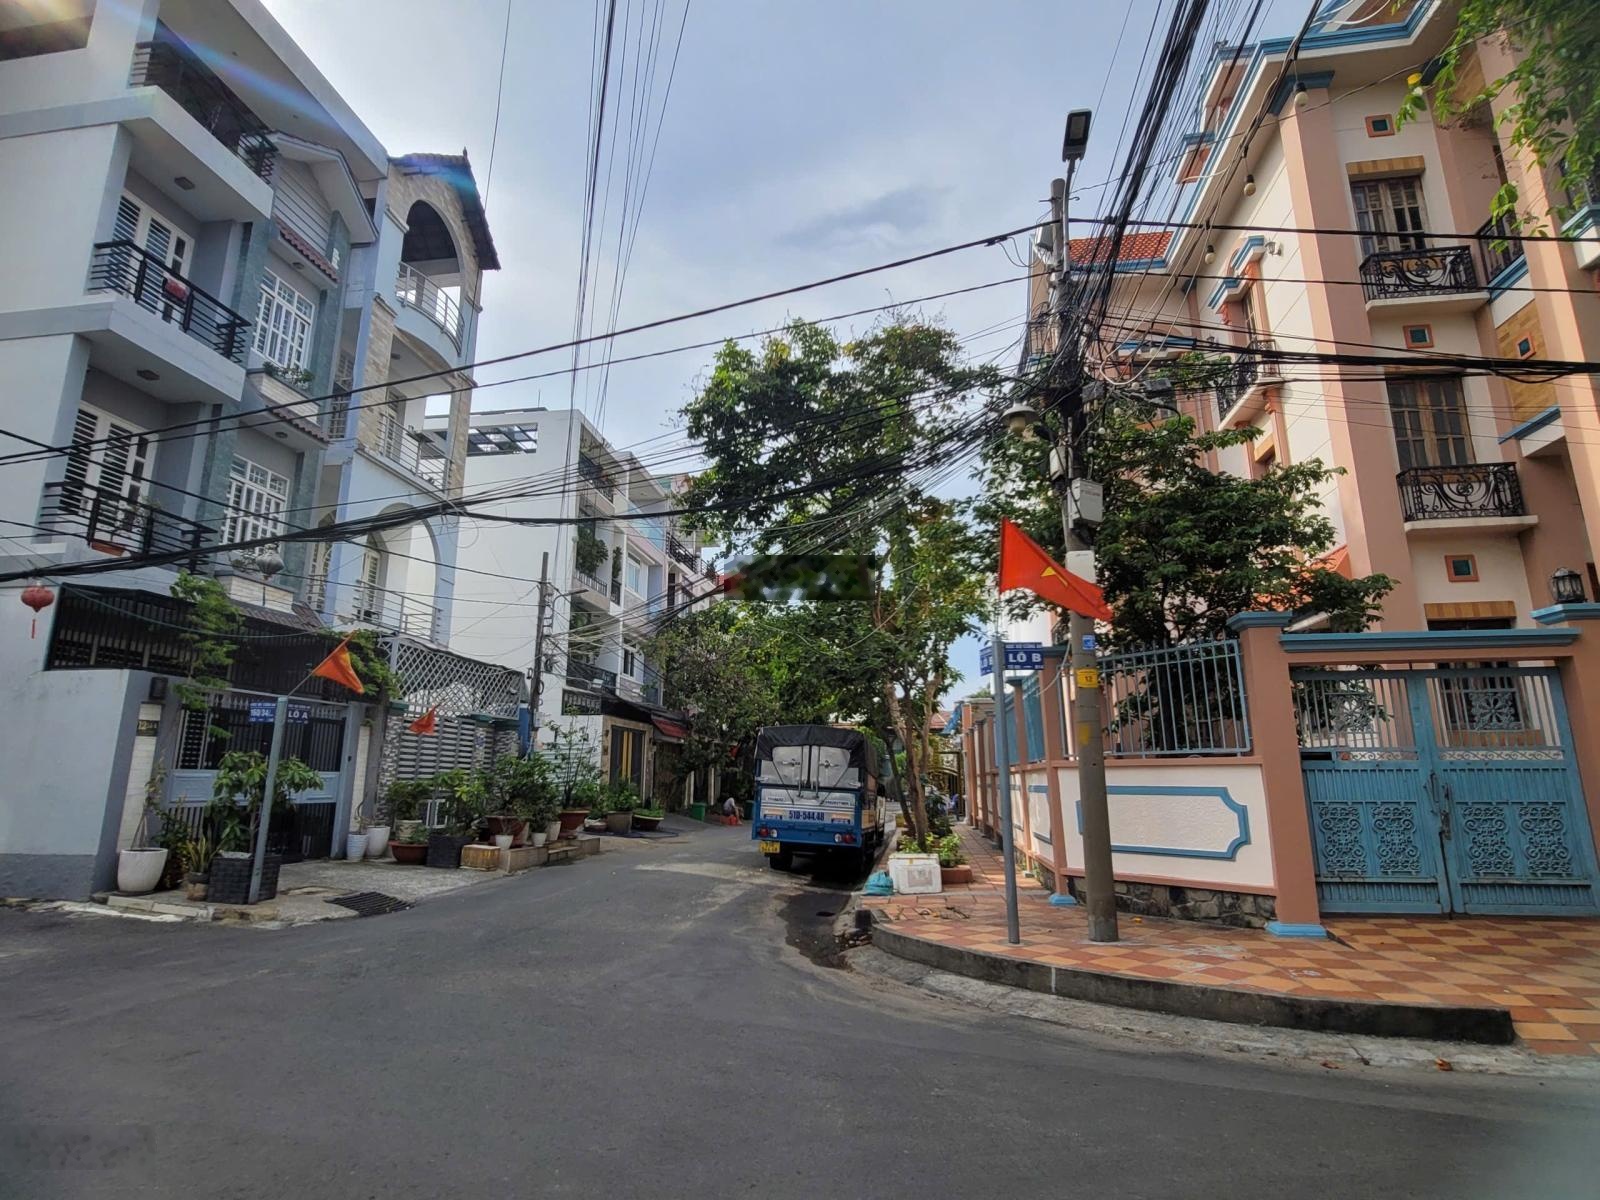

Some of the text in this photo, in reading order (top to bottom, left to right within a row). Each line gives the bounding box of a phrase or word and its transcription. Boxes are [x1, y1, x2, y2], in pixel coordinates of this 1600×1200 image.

[1008, 651, 1042, 662] LÔ B
[301, 711, 308, 719] A
